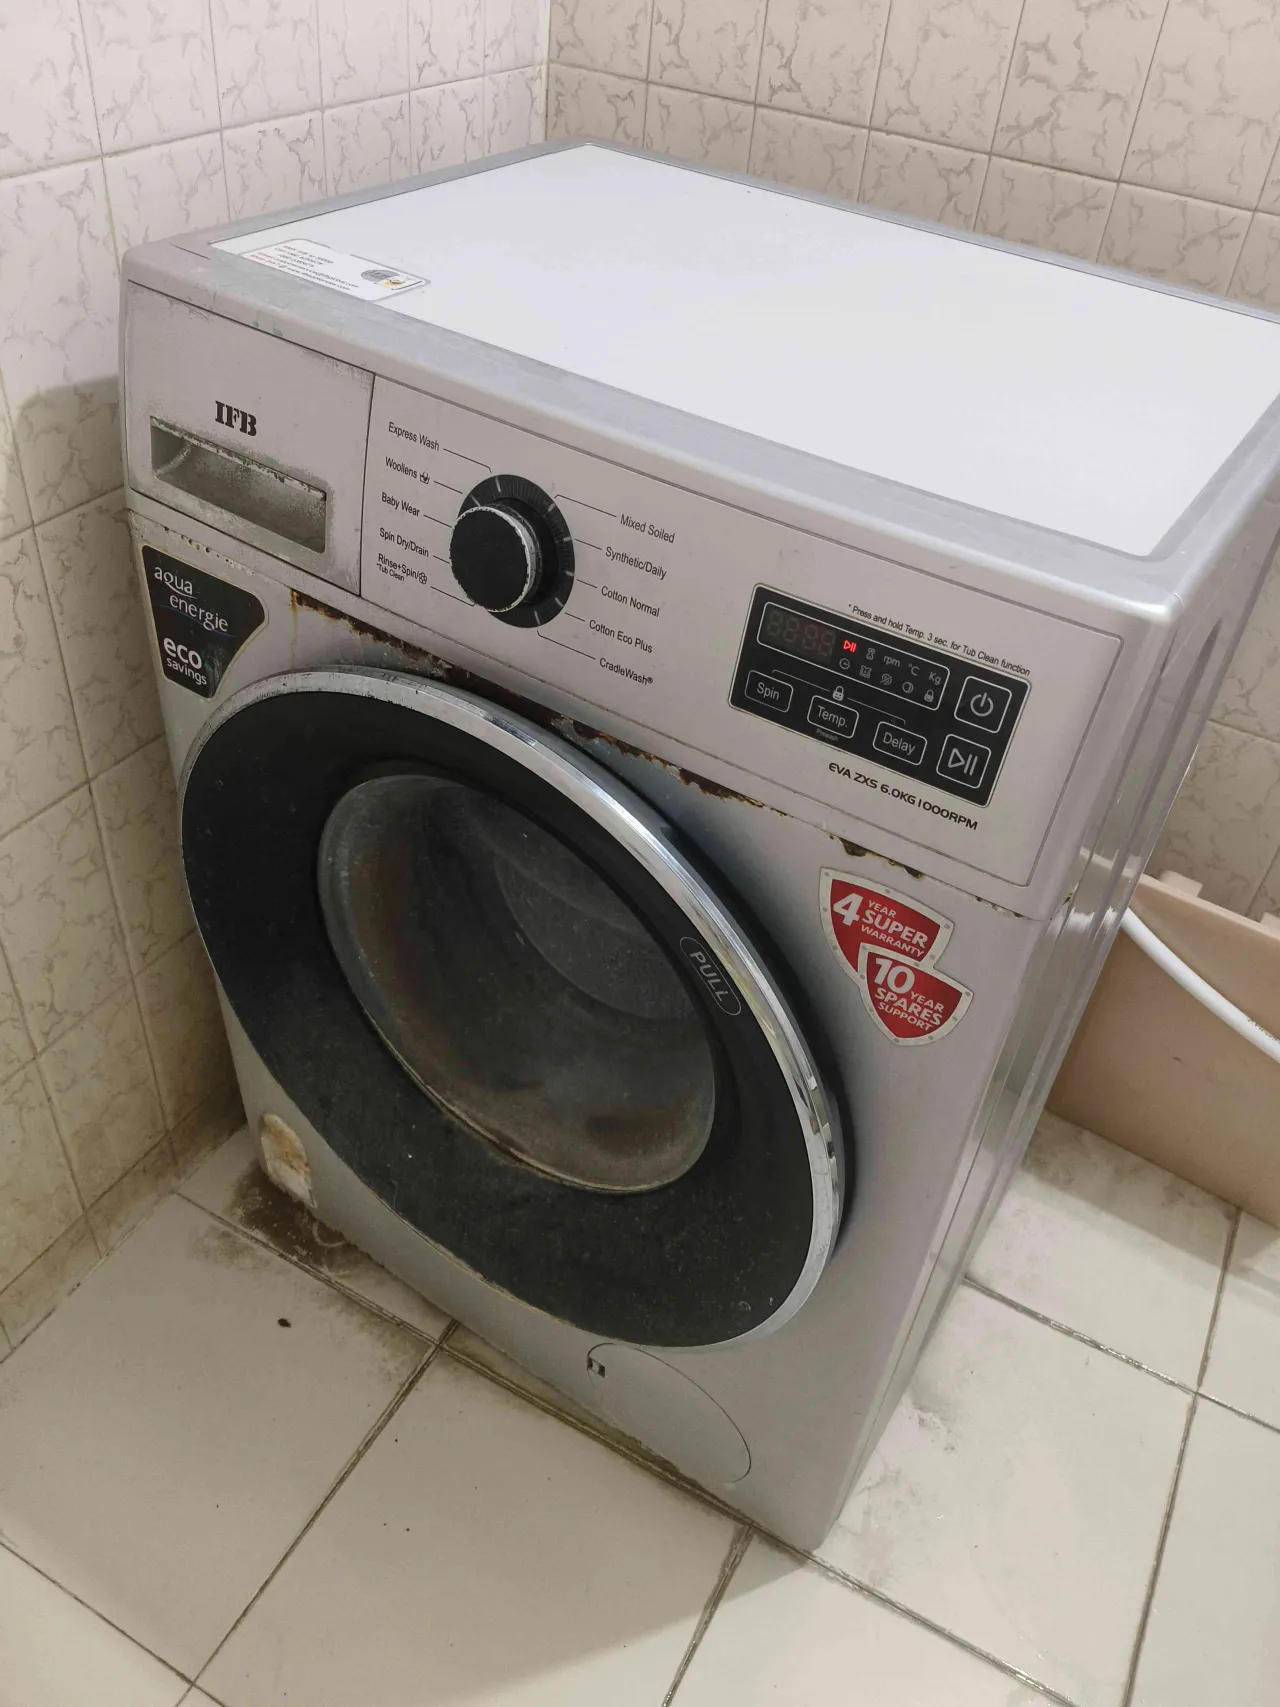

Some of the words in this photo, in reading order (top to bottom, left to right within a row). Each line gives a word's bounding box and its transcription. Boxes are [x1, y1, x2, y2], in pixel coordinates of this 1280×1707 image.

[215, 400, 257, 437] IFB
[388, 421, 417, 443] Express
[419, 433, 440, 451] Wash
[385, 456, 417, 479] Woollens
[381, 492, 400, 510] Baby
[401, 500, 420, 517] Wear
[379, 527, 395, 543] Spin
[396, 534, 429, 557] Dry/Drain
[620, 514, 646, 533] Mixed
[647, 525, 675, 543] Soiled
[389, 568, 405, 582] Clean
[605, 546, 667, 580] Synthetic/Daily
[154, 566, 194, 596] aqua
[169, 594, 229, 632] energie
[601, 586, 627, 605] Cotton
[629, 597, 660, 617] Normal
[589, 619, 615, 638] Cotton
[617, 630, 633, 645] Eco
[634, 637, 653, 653] Plus
[852, 605, 872, 620] Press
[873, 614, 887, 625] and
[888, 619, 903, 631] hold
[905, 624, 925, 639] Temp.
[927, 633, 933, 641] 3
[934, 637, 949, 648] sec.
[950, 641, 961, 651] for
[962, 645, 976, 657] Tub
[977, 650, 999, 666] Clean
[1001, 658, 1031, 677] function
[163, 636, 202, 670] eco
[166, 657, 208, 686] savings
[883, 655, 901, 668] rpm
[929, 671, 942, 686] Kg
[756, 682, 780, 701] Spin
[817, 704, 848, 728] Temp.
[883, 731, 916, 756] Delay
[828, 762, 851, 779] EVA
[853, 772, 879, 789] ZXS
[833, 893, 864, 926] 4
[868, 900, 897, 918] YEAR
[861, 924, 924, 957] WARRANTY
[862, 909, 928, 948] SUPER
[689, 951, 729, 1002] PULL
[874, 958, 915, 994] 10
[875, 987, 943, 1026] SPARES
[878, 1001, 933, 1031] SUPPORT
[910, 991, 945, 1013] YEAR
